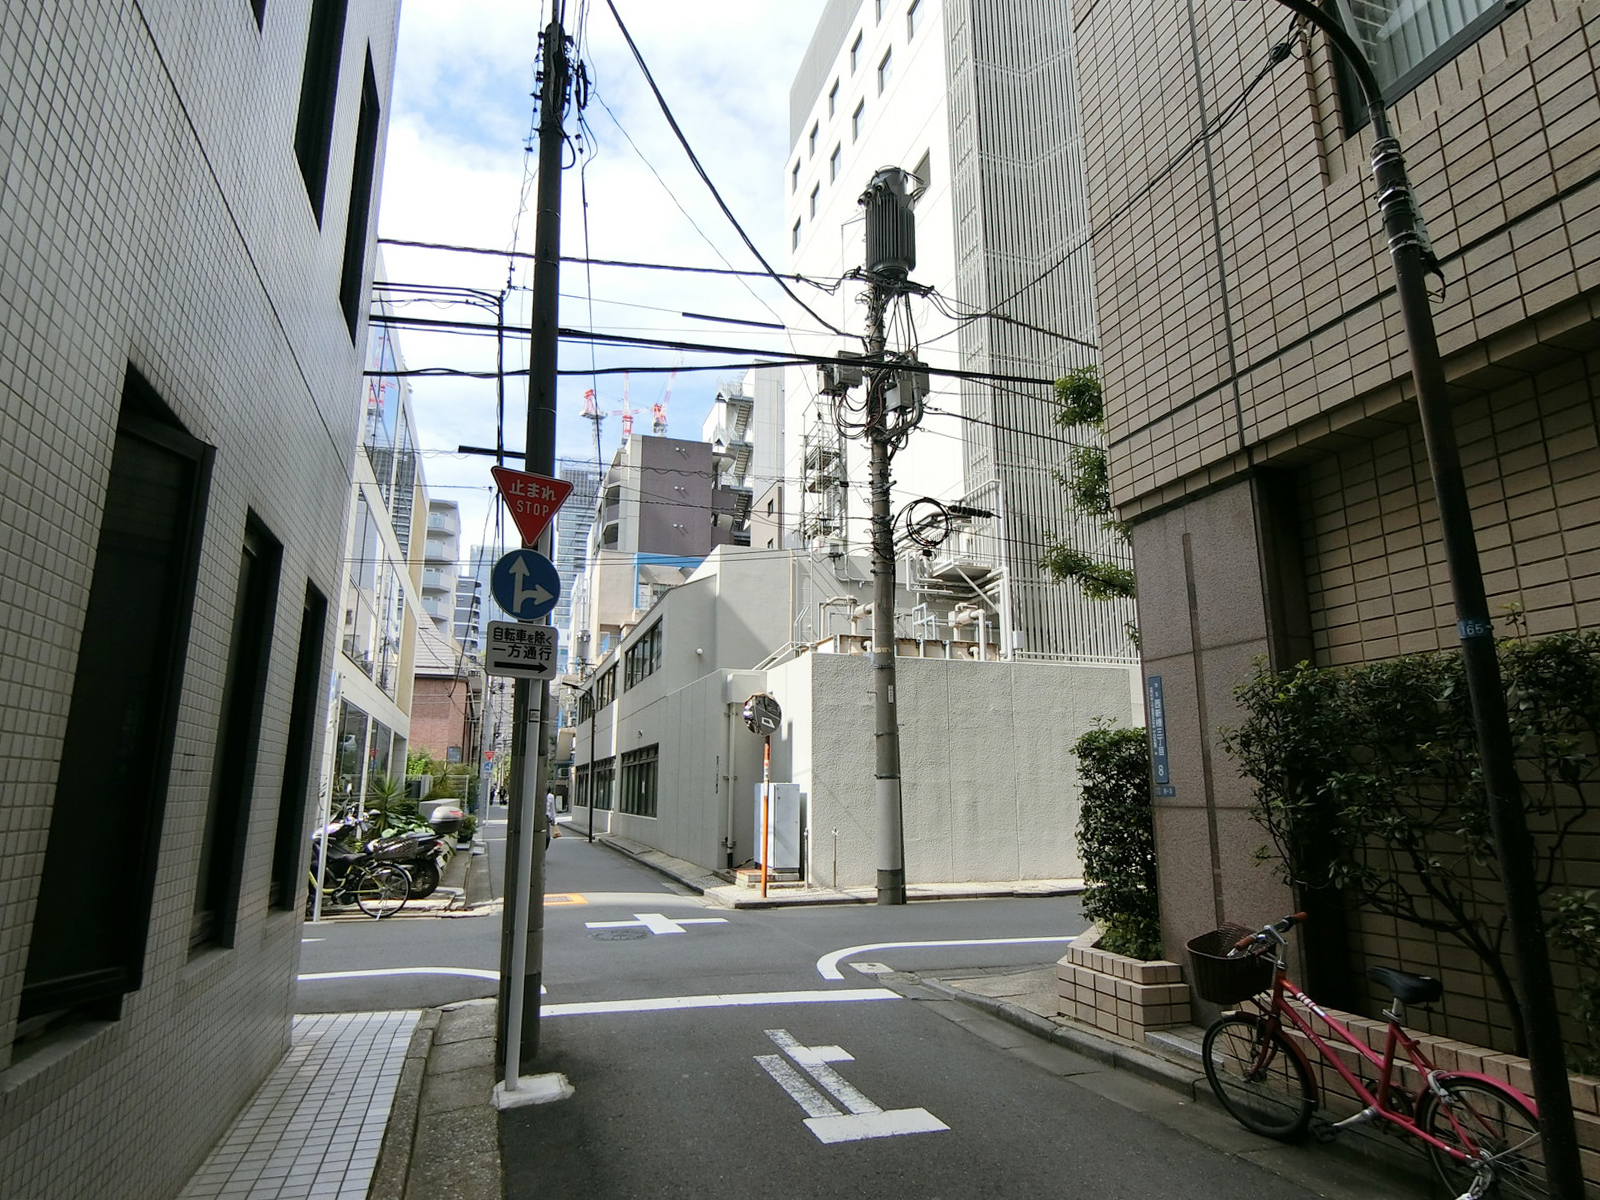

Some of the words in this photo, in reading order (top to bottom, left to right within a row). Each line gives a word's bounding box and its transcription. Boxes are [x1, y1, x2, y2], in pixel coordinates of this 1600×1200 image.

[509, 479, 556, 501] 止まれ
[516, 500, 550, 517] STOP
[493, 626, 552, 646] 自転車を除く
[1461, 623, 1484, 636] 165
[492, 644, 552, 661] 一方通行
[1157, 764, 1164, 776] 8
